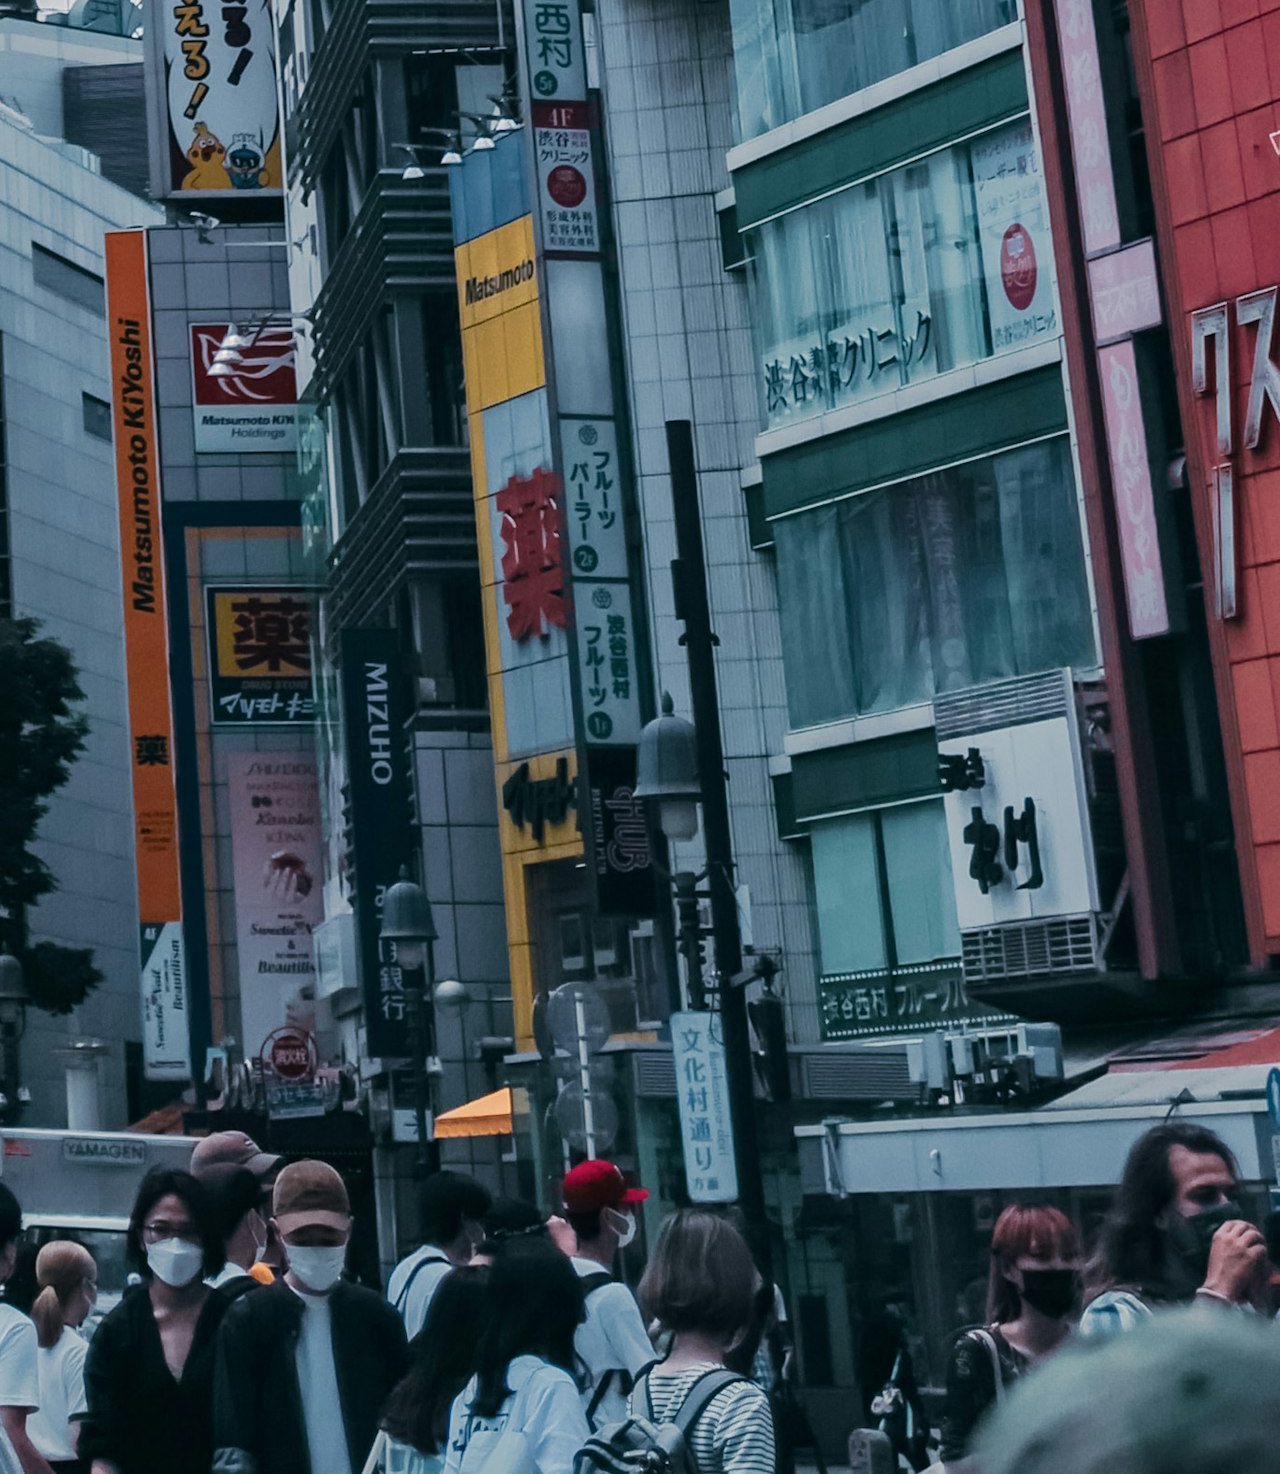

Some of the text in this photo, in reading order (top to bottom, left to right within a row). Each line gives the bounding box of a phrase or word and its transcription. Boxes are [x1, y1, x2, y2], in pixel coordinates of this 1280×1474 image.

[547, 107, 574, 127] 4F
[538, 130, 570, 148] 渋谷
[539, 149, 589, 163] クリニック
[464, 257, 535, 306] Matsumoto
[201, 415, 270, 426] Matsumoto
[231, 427, 286, 440] Holdings
[118, 318, 156, 614] Matsumoto KiYoshi
[592, 450, 617, 530] フルーツ
[584, 625, 607, 707] フルーツ
[607, 613, 631, 700] 渋谷西村
[363, 661, 394, 786] MIZUHO
[135, 733, 170, 766] 薬
[680, 1028, 714, 1171] 文化村通り
[66, 1142, 144, 1159] YAMAGEN
